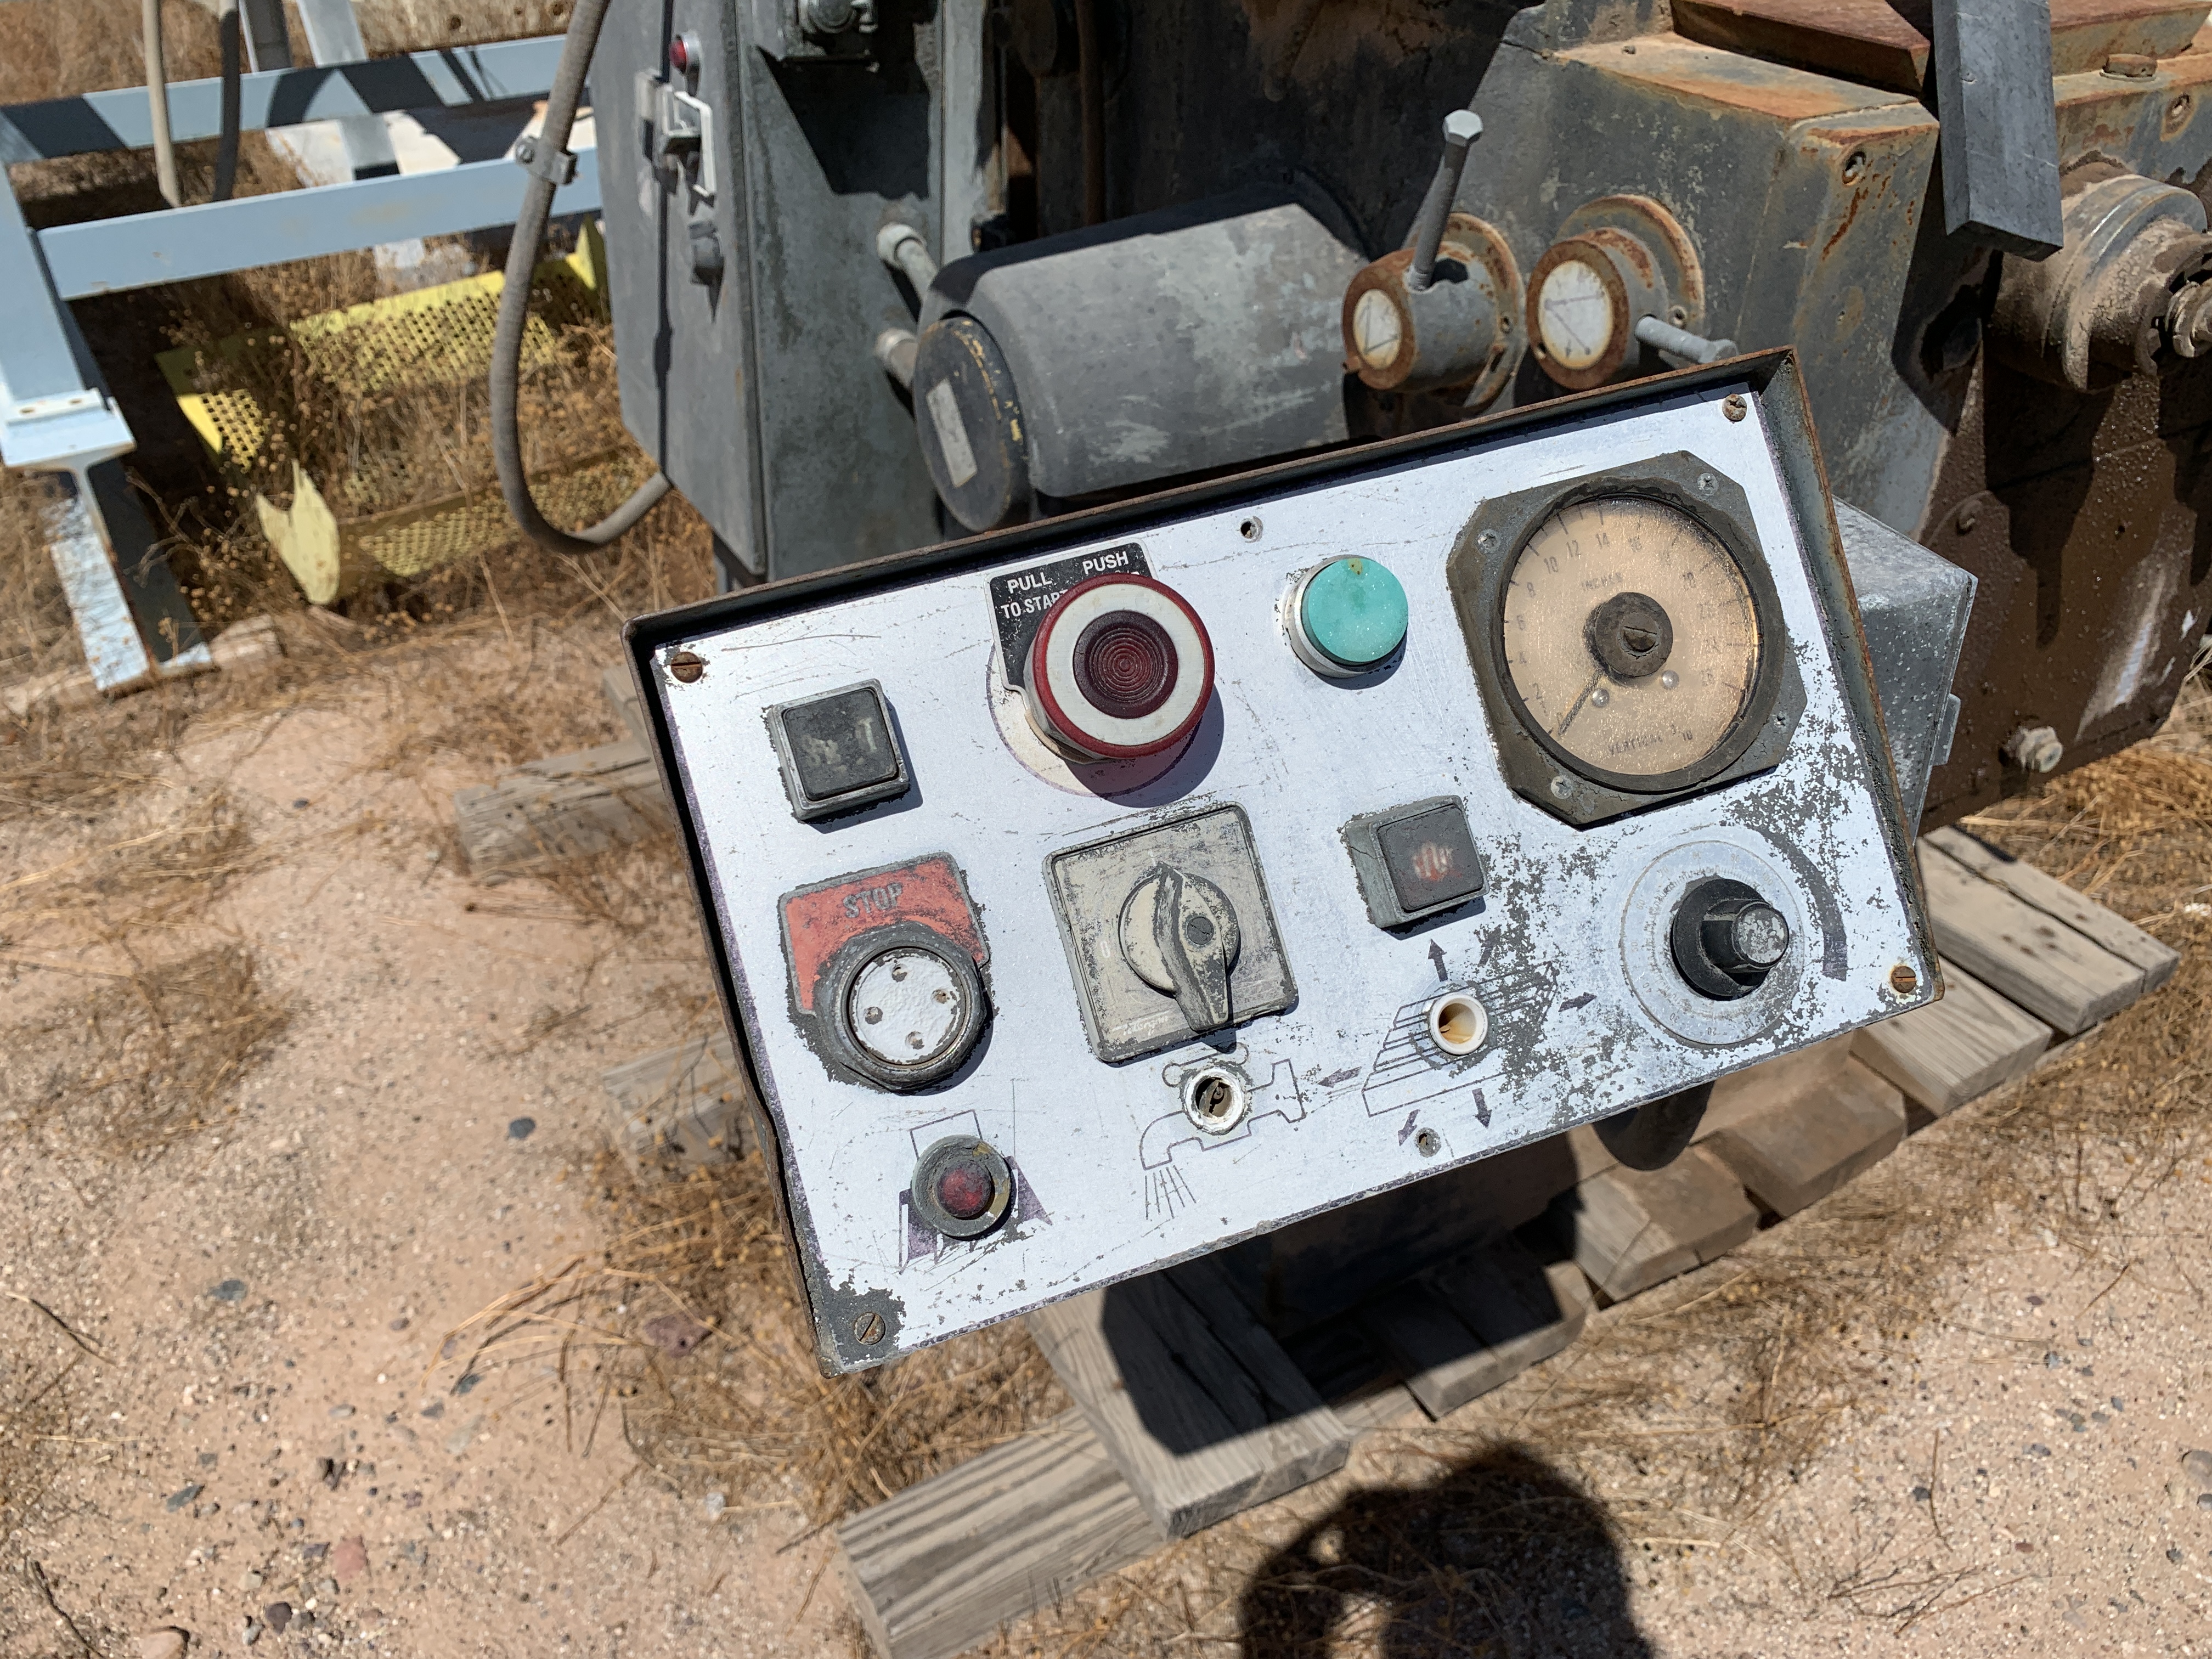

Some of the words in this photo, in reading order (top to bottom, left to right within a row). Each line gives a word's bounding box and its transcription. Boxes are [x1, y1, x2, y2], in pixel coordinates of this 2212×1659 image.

[1566, 539, 1581, 557] 12
[1595, 532, 1610, 550] 14
[1082, 550, 1129, 575] PUSH
[1544, 556, 1559, 574] 10
[1007, 572, 1052, 594] PULL
[1526, 582, 1536, 598] 8
[1001, 603, 1022, 619] TO
[1024, 589, 1068, 614] STAR
[1533, 682, 1542, 699] 2
[842, 882, 904, 918] STOP
